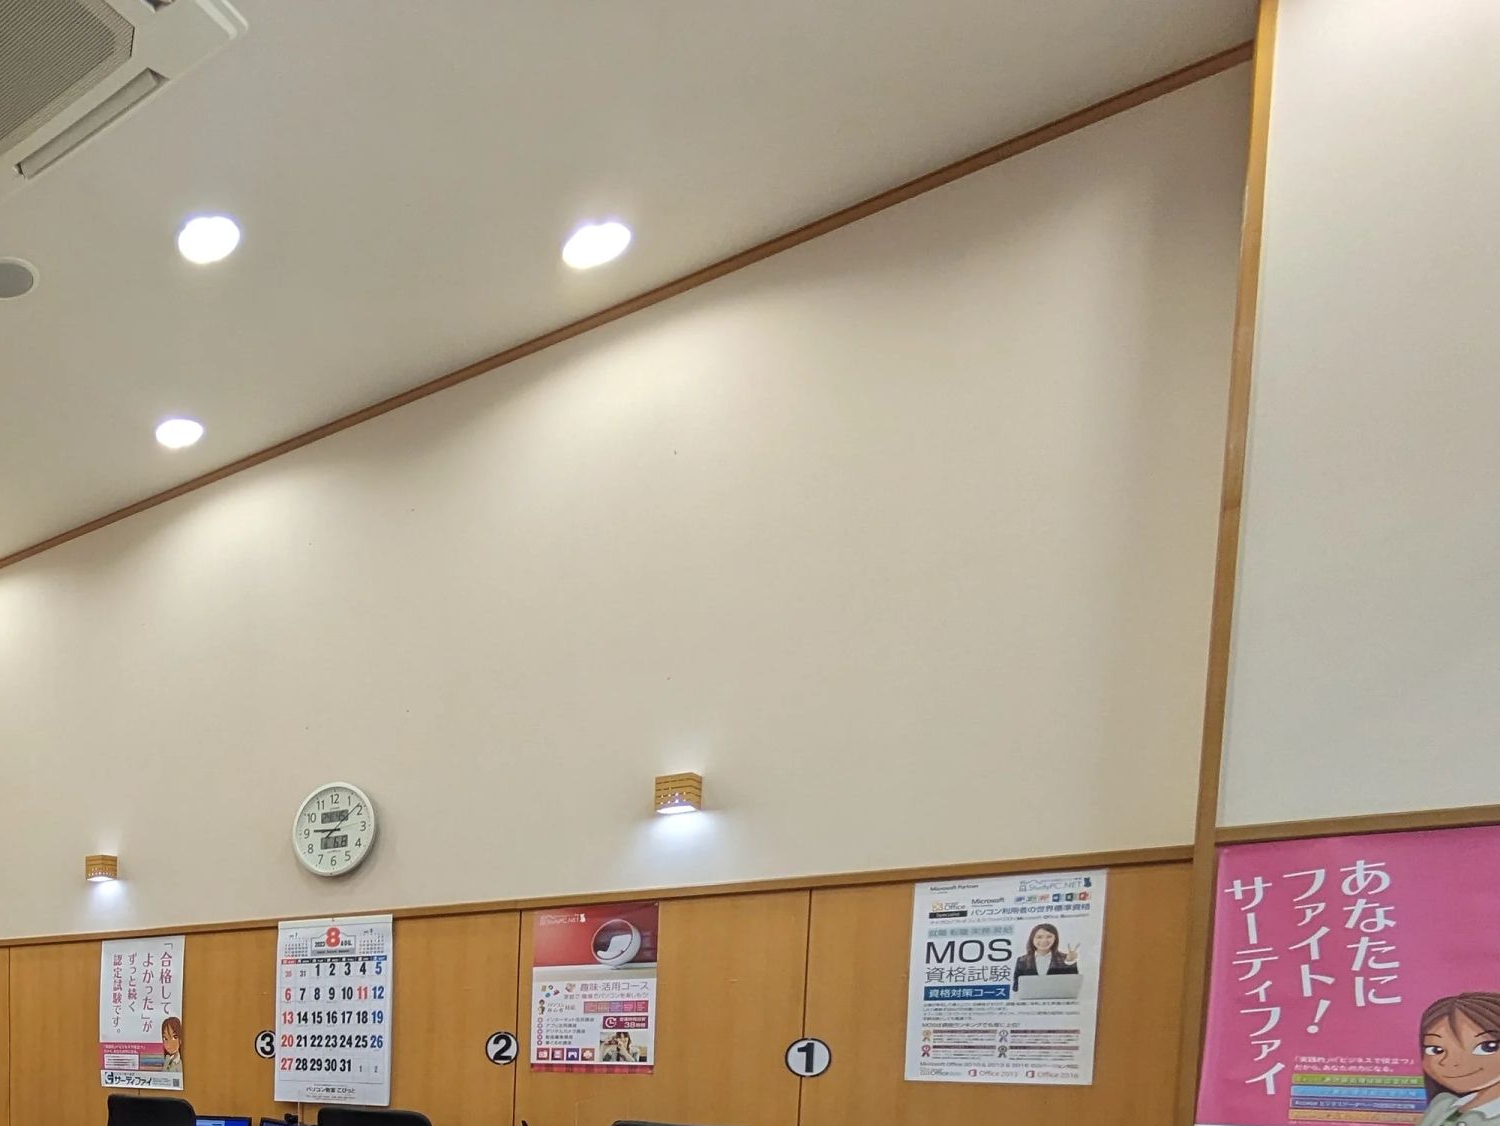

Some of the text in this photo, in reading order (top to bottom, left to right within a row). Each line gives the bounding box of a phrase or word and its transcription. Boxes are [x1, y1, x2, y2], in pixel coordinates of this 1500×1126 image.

[317, 800, 324, 810] 11
[330, 794, 339, 804] 12
[348, 796, 351, 806] 1
[357, 805, 363, 816] 2
[307, 813, 316, 823] 10
[360, 821, 366, 831] 3
[304, 829, 310, 839] 9
[307, 844, 314, 854] 8
[355, 838, 361, 848] 4
[318, 855, 324, 864] 7
[331, 856, 336, 866] 6
[345, 851, 351, 861] 5
[326, 927, 340, 948] 8
[1340, 860, 1401, 1007] あなたに
[925, 938, 1013, 965] MOS
[315, 964, 320, 976] 1
[329, 963, 335, 976] 2
[344, 963, 351, 975] 3
[360, 962, 366, 975] 4
[375, 962, 382, 974] 5
[924, 965, 1011, 984] 資格試験
[128, 952, 138, 1013] ずっと続く
[1224, 876, 1286, 1095] サーティファイ
[285, 986, 384, 1000] 6 7 8 9 10 11 12
[928, 987, 1007, 999] 資格対策コース
[282, 1010, 383, 1024] 13 14 15 16 17 18 19
[260, 1034, 275, 1056] 3
[281, 1035, 383, 1048] 20 21 22 23 24 25 26
[493, 1034, 512, 1060] 2
[798, 1042, 814, 1072] 1
[281, 1058, 293, 1070] 27
[295, 1058, 308, 1071] 28
[310, 1058, 322, 1071] 29
[324, 1058, 337, 1071] 30
[340, 1059, 351, 1071] 31
[114, 1075, 152, 1086] サーティファイ
